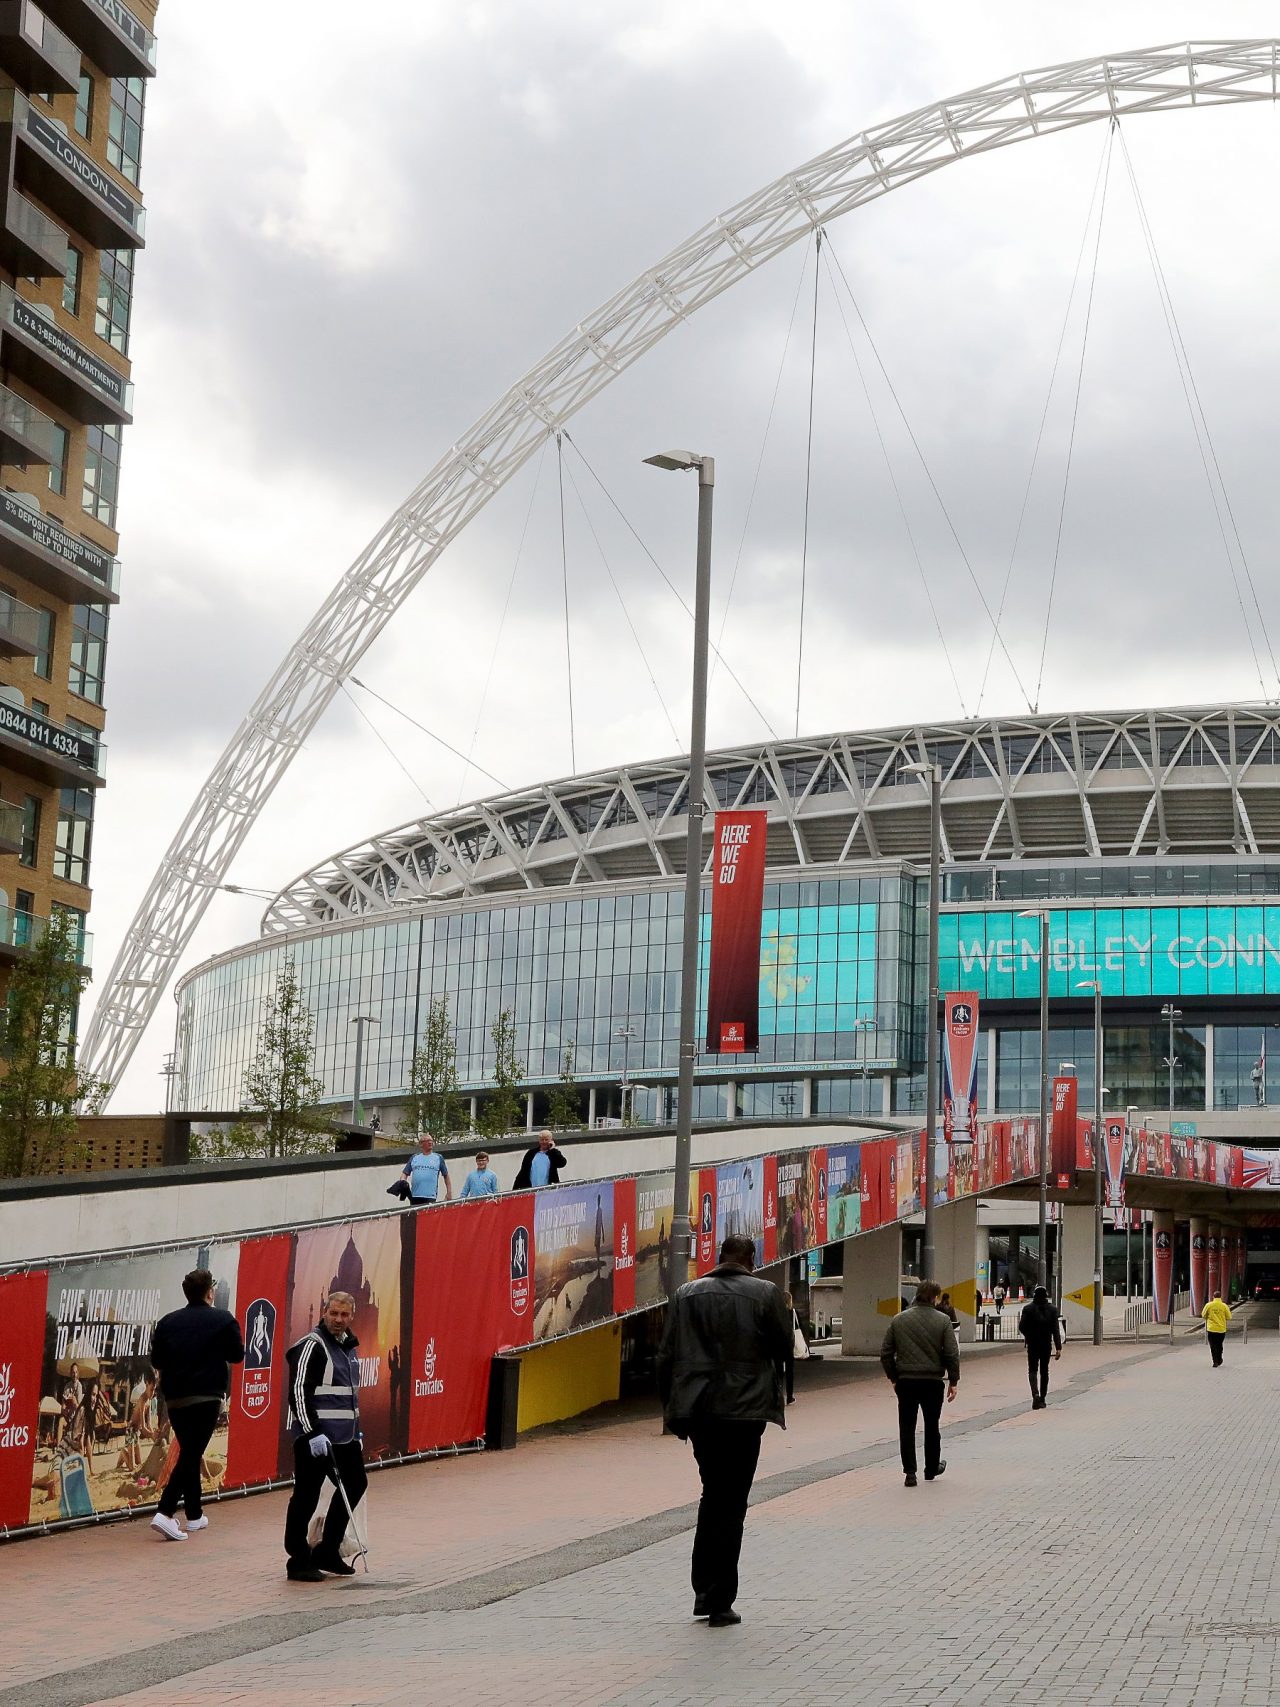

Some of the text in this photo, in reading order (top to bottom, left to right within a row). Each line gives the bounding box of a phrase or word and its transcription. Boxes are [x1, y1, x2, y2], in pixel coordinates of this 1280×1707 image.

[98, 0, 139, 39] ATT
[57, 139, 108, 197] LONDON
[16, 309, 119, 393] 1, 2 & 3-BEDROOM APARTMENTS
[5, 500, 102, 568] 5% DEPOSIT REQUIRED WITH
[33, 530, 77, 563] HELP TO BUY
[0, 707, 79, 757] 0844 811 4334
[720, 825, 751, 844] HERE
[720, 845, 740, 864] WE
[719, 865, 737, 884] GO
[958, 934, 1157, 973] WEMBLEY
[1056, 1083, 1070, 1093] HERE
[1056, 1093, 1066, 1102] WE
[59, 1289, 160, 1323] GIVE NEW MEANING
[55, 1325, 68, 1360] TO
[71, 1325, 110, 1359] FAMILY
[111, 1325, 137, 1357] TIME
[245, 1382, 268, 1395] Emirates
[415, 1378, 443, 1396] Emirates
